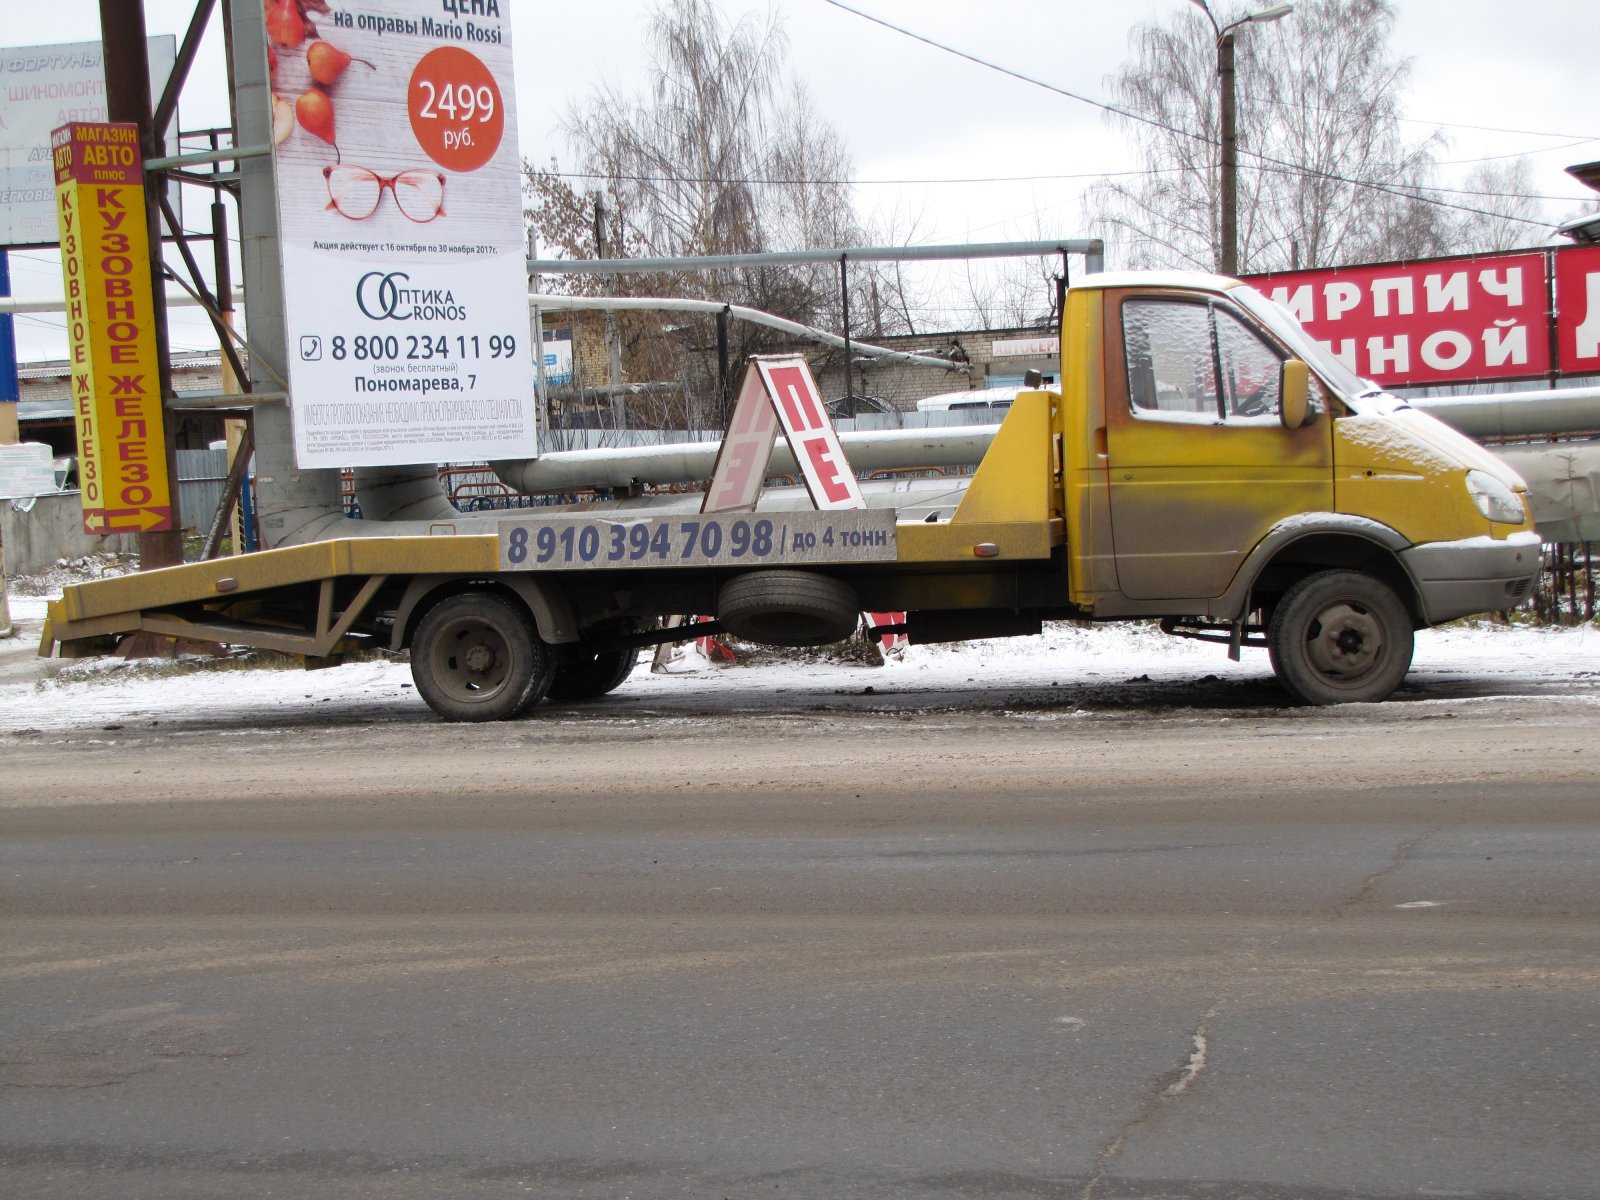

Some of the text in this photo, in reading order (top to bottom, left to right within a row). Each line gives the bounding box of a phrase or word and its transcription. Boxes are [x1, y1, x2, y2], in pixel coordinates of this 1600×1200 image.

[334, 12, 502, 44] на оправы Mario Rossi
[8, 52, 101, 73] ФОРТУНЫ
[419, 81, 494, 123] 2499
[76, 127, 137, 143] МАГАЗИН
[444, 127, 475, 150] руб.
[55, 145, 72, 170] АВТО
[83, 145, 135, 166] АВТО
[313, 241, 339, 253] Акция
[340, 242, 379, 254] действует
[386, 243, 395, 252] 16
[396, 243, 427, 255] октября
[439, 244, 448, 253] 30
[449, 245, 475, 256] ноября
[476, 246, 499, 255] 2017г.
[1258, 267, 1523, 323] ИРПИЧ
[61, 190, 98, 501] КУЗОВНОЕ ЖЕЛЕЗО
[96, 188, 152, 505] КУЗОВНОЕ ЖЕЛЕЗО
[332, 335, 516, 361] 8 800 234 11 99
[373, 362, 459, 375] (звонок бесплатный)
[355, 374, 477, 395] Пономарева, 7
[508, 527, 528, 564] 8
[536, 525, 600, 563] 910
[608, 523, 671, 561] 394
[681, 521, 723, 558] 70
[731, 519, 773, 557] 98
[792, 531, 816, 552] до
[822, 526, 835, 547] 4
[840, 530, 887, 547] тонн
